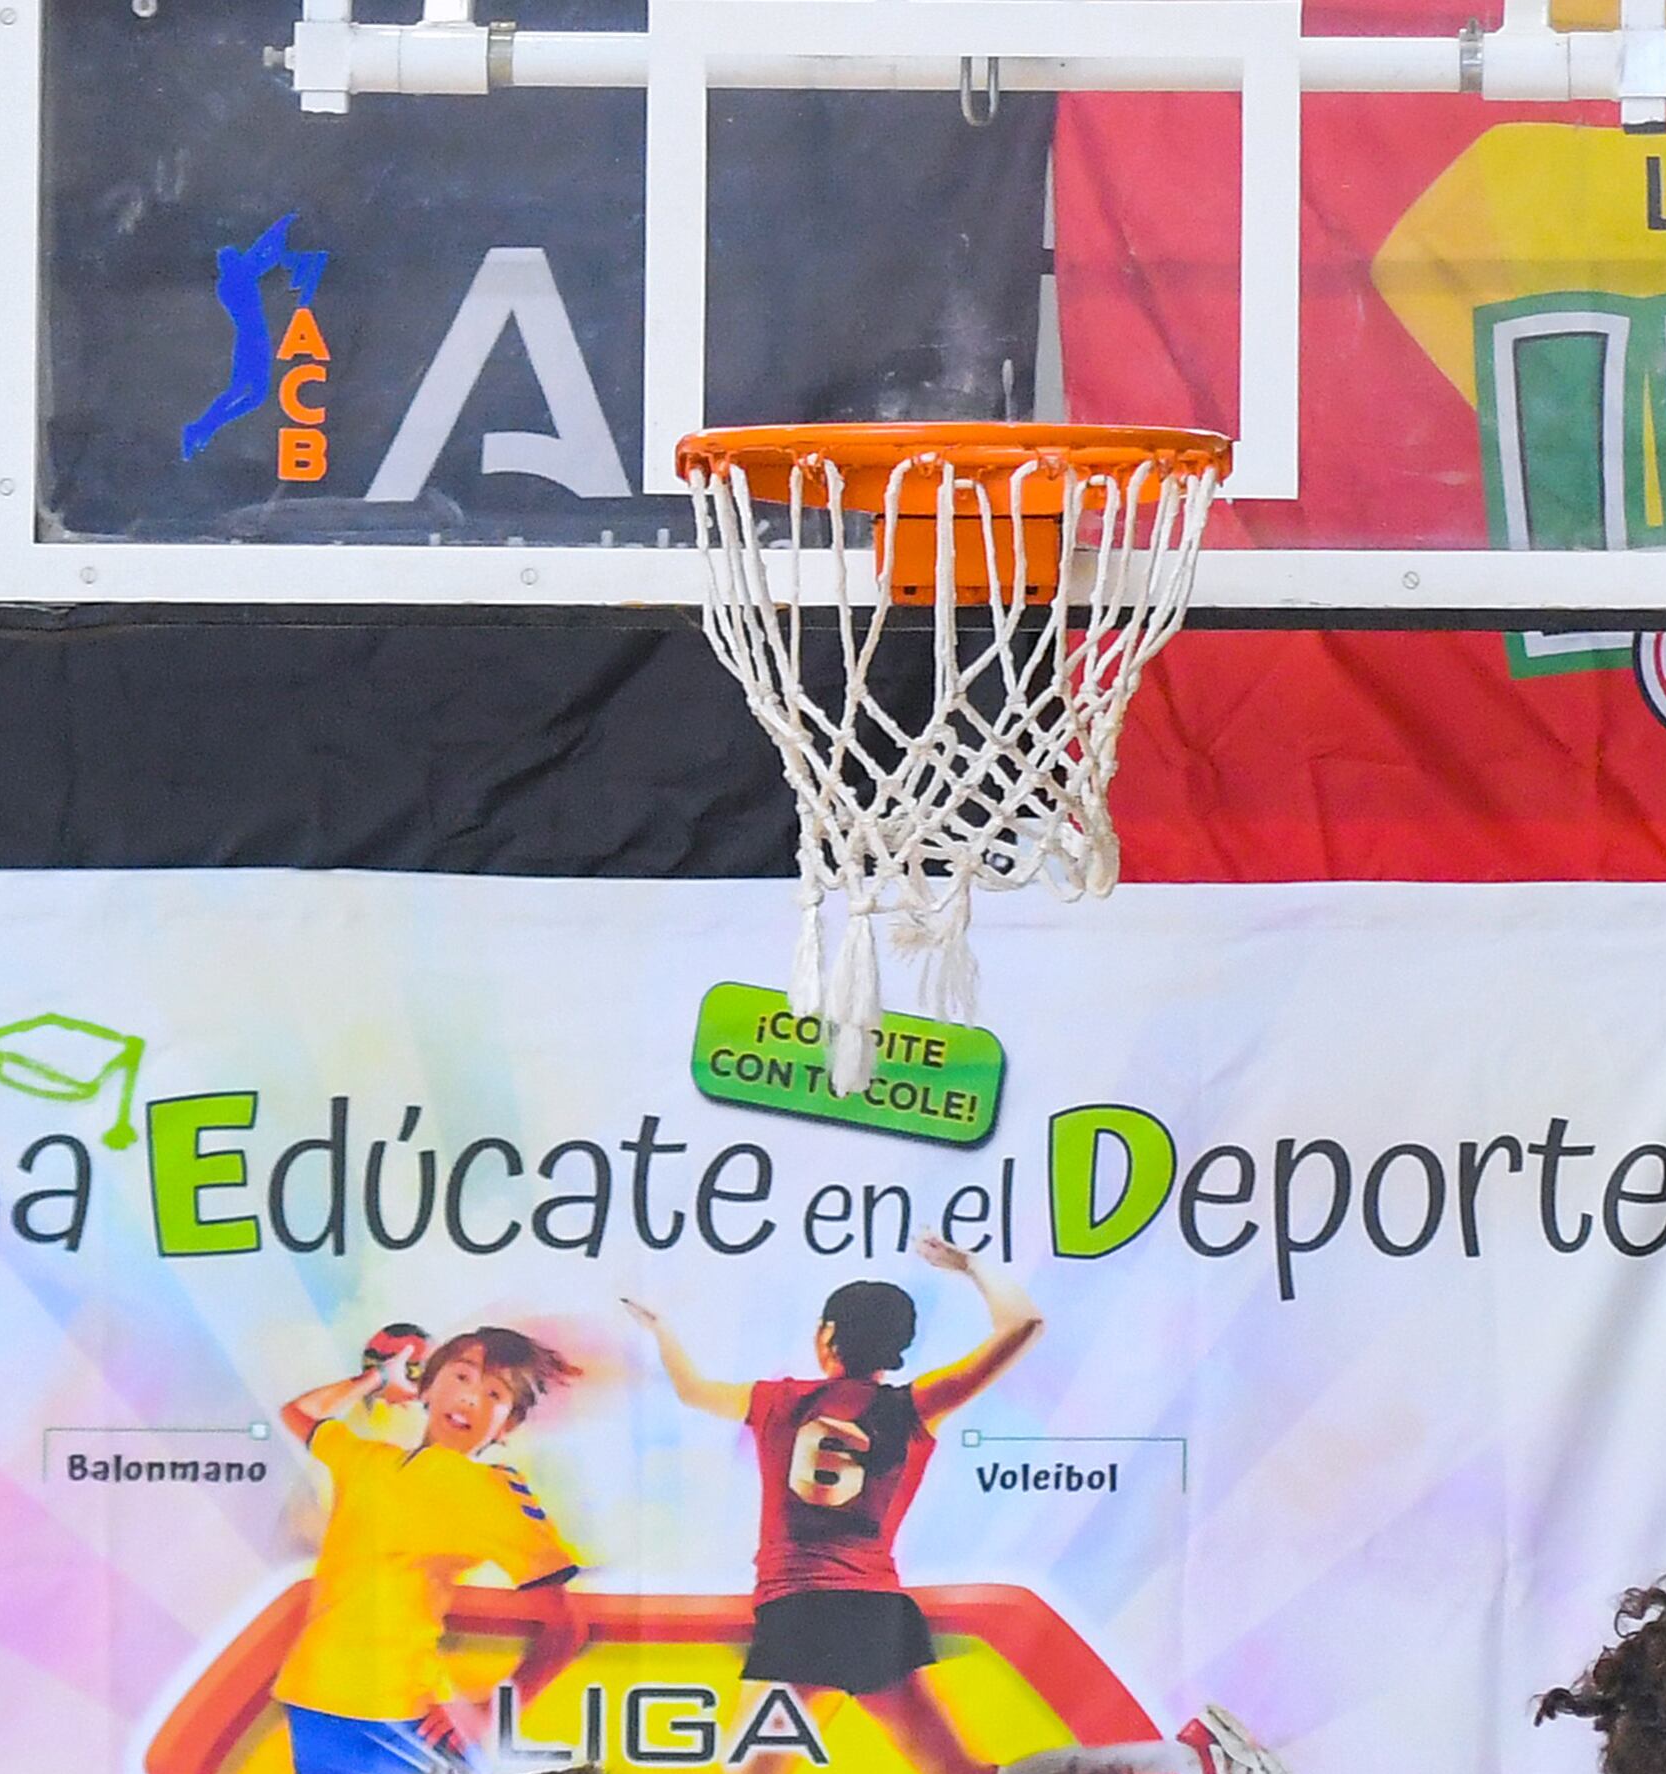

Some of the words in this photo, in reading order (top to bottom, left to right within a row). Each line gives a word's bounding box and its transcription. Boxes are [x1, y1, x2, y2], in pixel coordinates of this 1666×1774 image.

[275, 308, 330, 482] ACB
[709, 1048, 794, 1089] CON
[863, 1077, 979, 1124] COLE!
[145, 1090, 775, 1260] Edúcate
[803, 1184, 911, 1259] en
[938, 1155, 1015, 1266] el
[68, 1454, 267, 1482] Balonmano
[787, 1413, 873, 1509] 6
[976, 1462, 1118, 1493] Voleibol
[495, 1684, 829, 1768] LIGA
